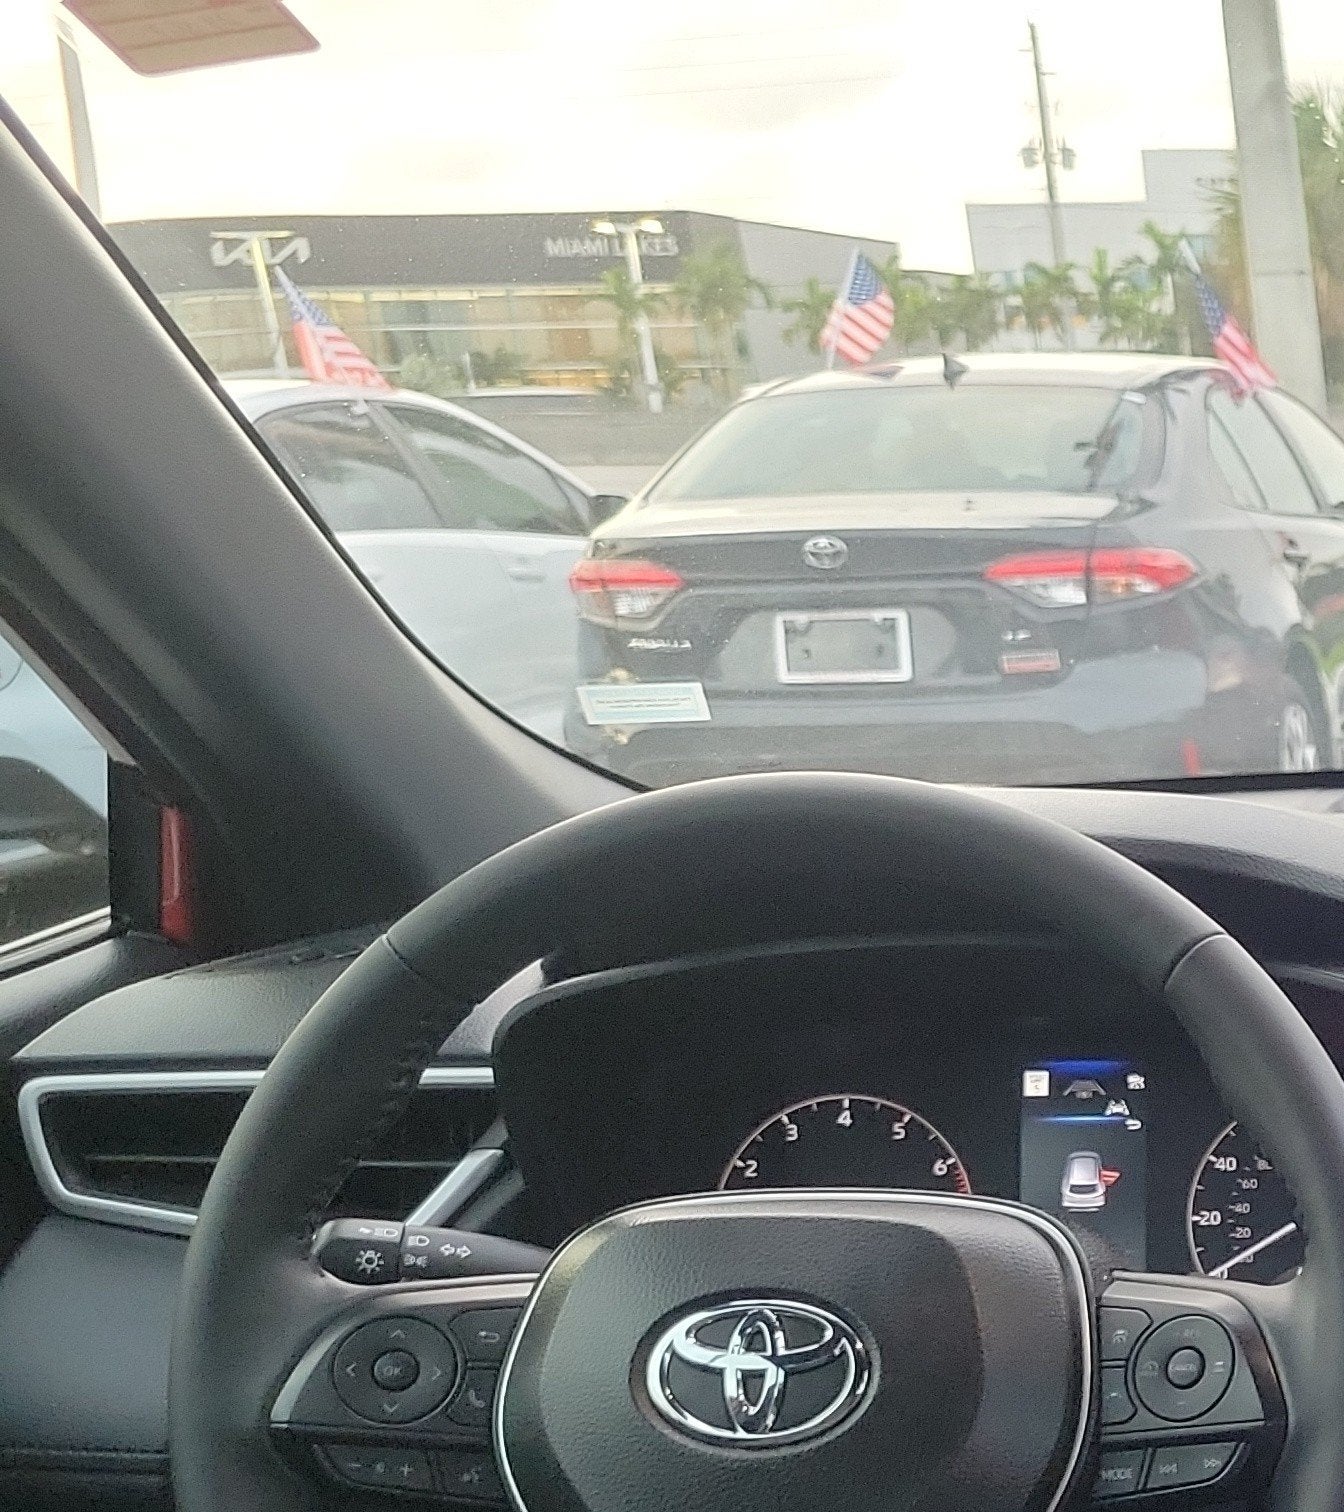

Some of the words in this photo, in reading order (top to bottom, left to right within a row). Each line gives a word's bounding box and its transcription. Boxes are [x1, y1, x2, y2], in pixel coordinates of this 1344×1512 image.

[545, 236, 609, 257] MIAMI
[612, 236, 678, 257] LKES
[837, 1110, 853, 1127] 4
[785, 1123, 799, 1141] 3
[891, 1122, 906, 1140] 5
[743, 1160, 758, 1177] 2
[932, 1158, 948, 1176] 6
[1214, 1156, 1238, 1171] 40
[1199, 1210, 1222, 1226] 20
